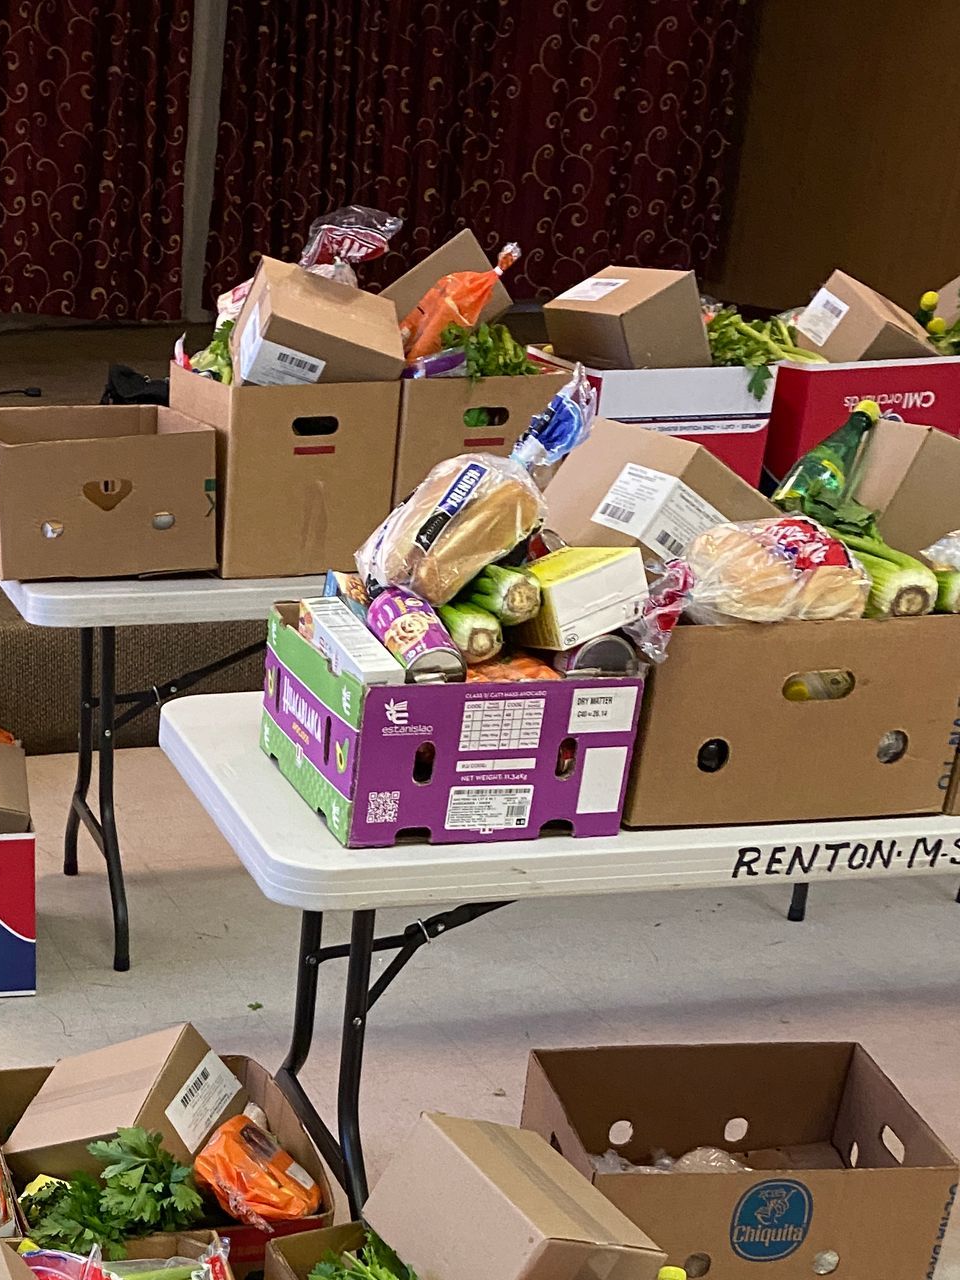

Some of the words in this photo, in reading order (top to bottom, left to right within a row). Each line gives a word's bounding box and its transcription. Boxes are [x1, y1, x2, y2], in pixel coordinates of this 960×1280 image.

[843, 393, 902, 412] orcds
[902, 391, 936, 409] CMI
[577, 697, 589, 706] DRY
[590, 696, 613, 705] MATTER
[732, 1224, 805, 1247] Chiquita
